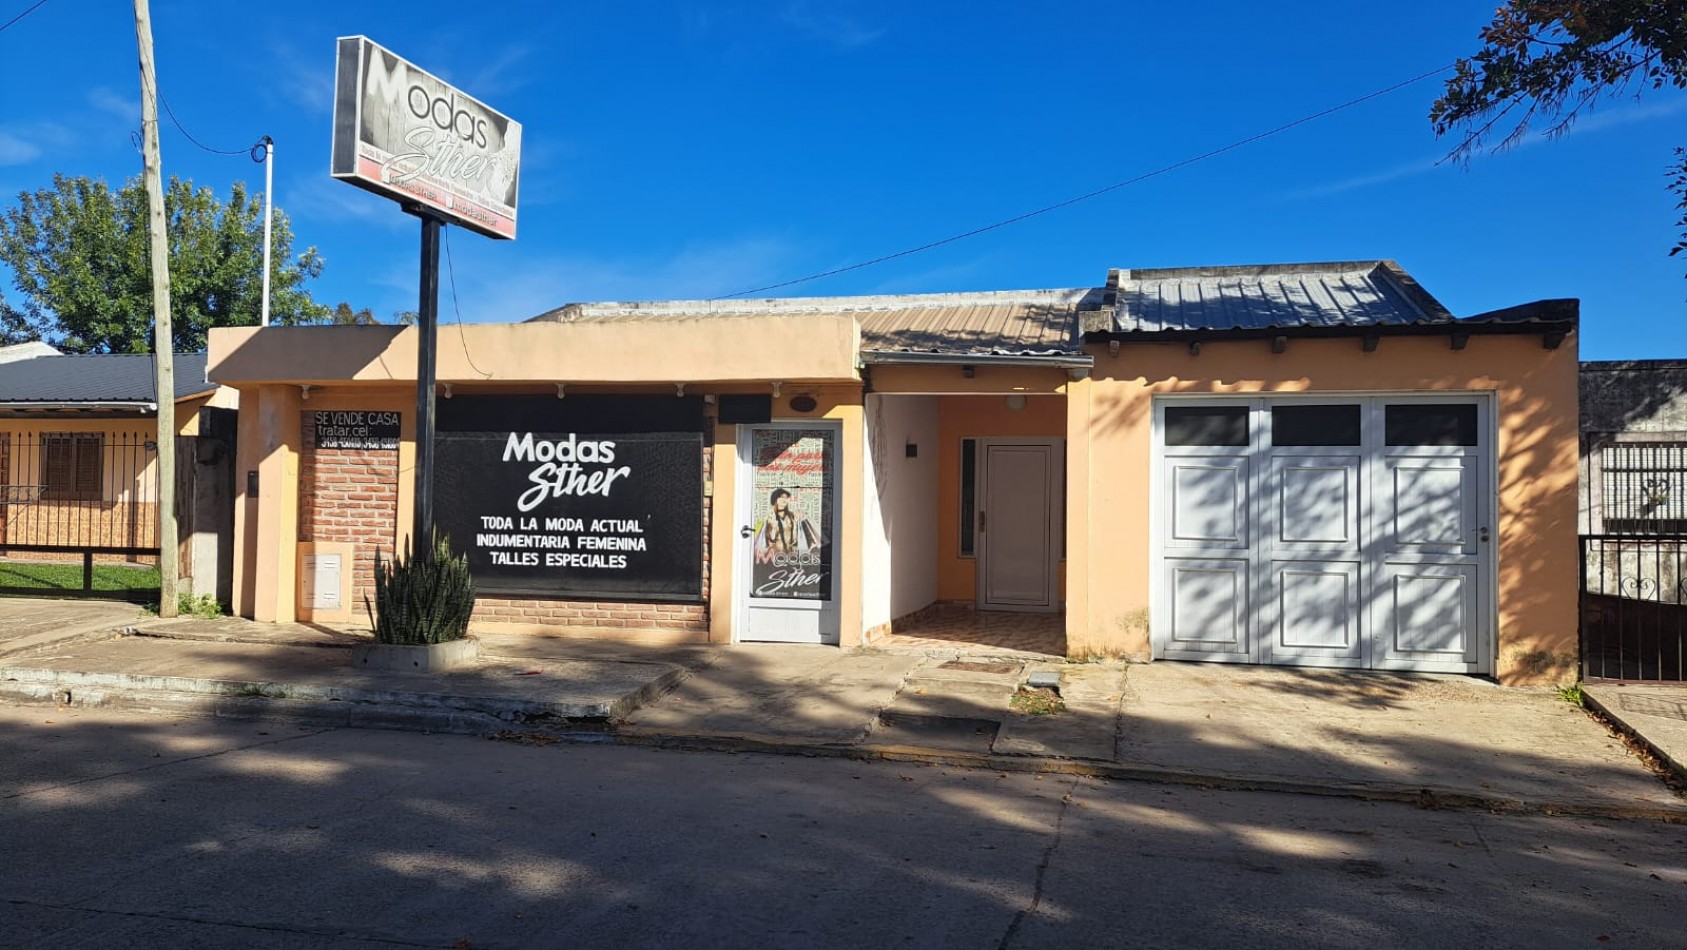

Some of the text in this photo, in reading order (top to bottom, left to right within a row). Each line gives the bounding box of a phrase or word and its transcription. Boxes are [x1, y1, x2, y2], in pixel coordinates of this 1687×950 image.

[366, 45, 488, 149] Modas
[381, 127, 497, 183] Sther
[315, 411, 399, 426] SE VENDE CASA
[502, 431, 616, 463] Modas
[517, 462, 631, 512] Sther
[480, 515, 643, 533] TODA LA MODA ACTUAL
[476, 533, 647, 551] INDUMENTARIA FEMENINA
[489, 551, 627, 569] TALLES ESPECIALES
[755, 567, 830, 595] Sther
